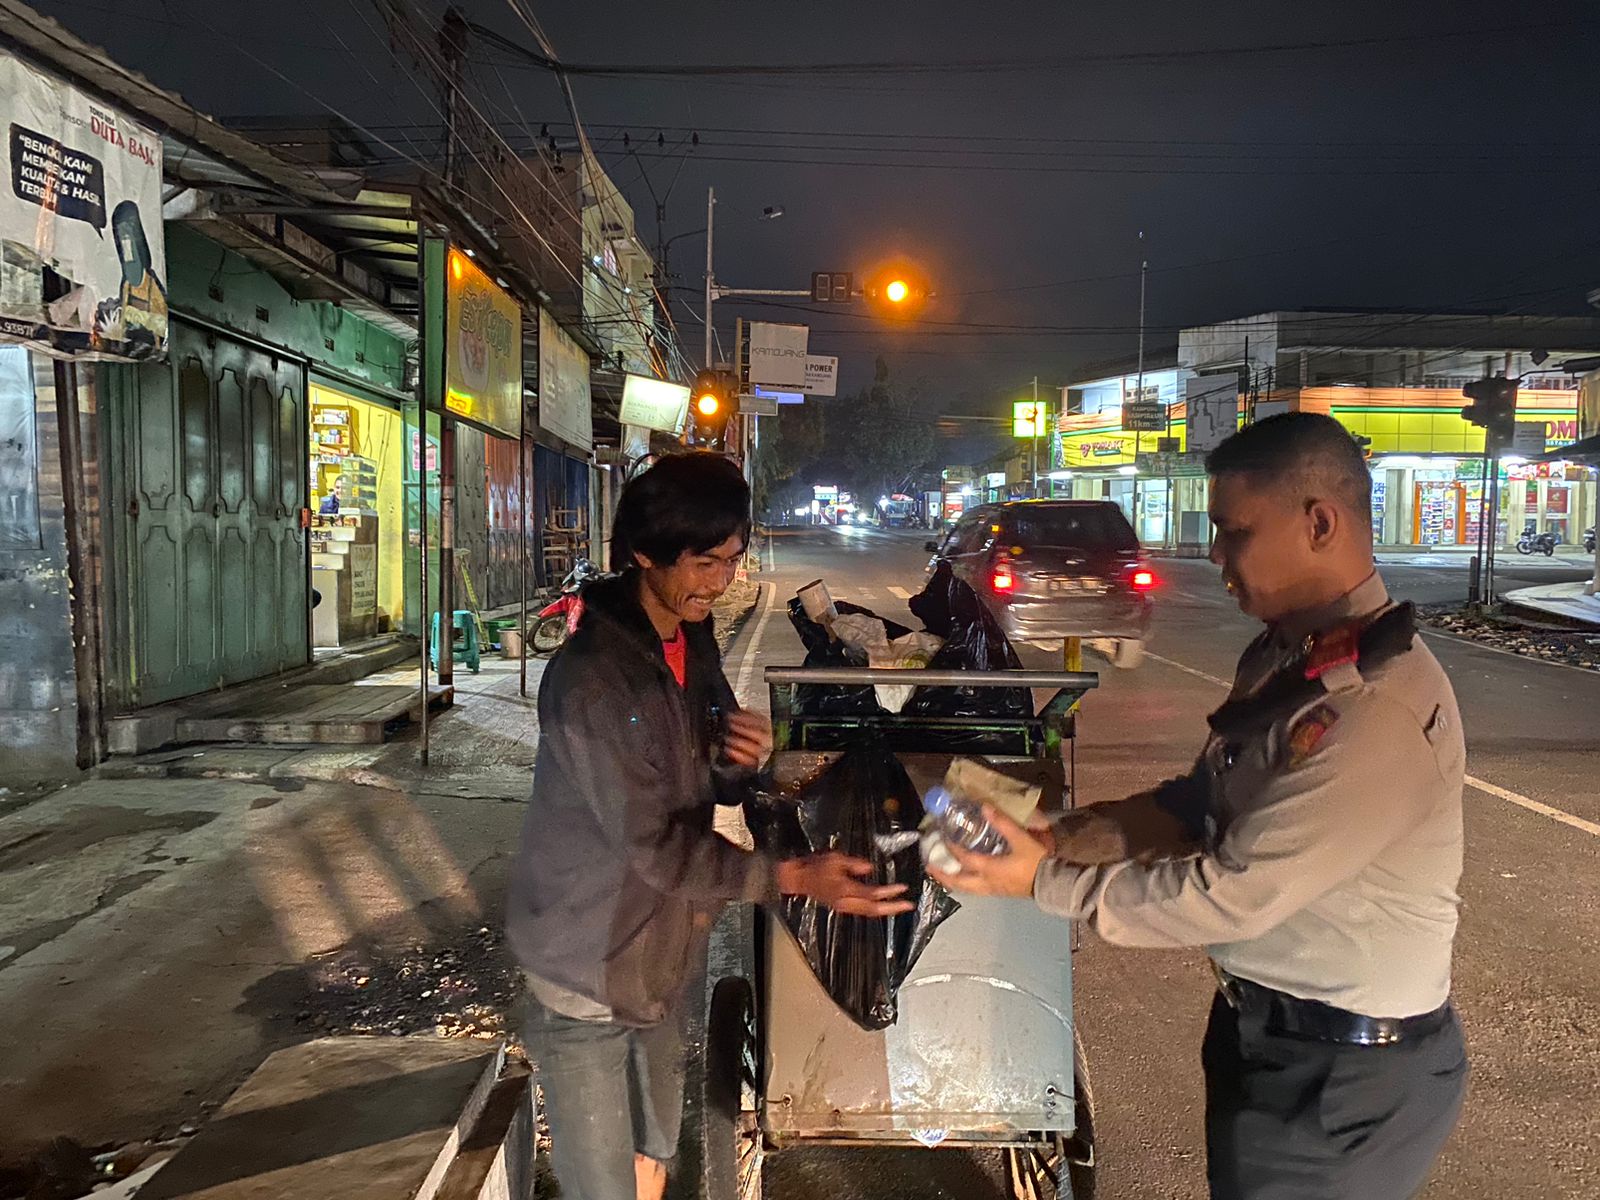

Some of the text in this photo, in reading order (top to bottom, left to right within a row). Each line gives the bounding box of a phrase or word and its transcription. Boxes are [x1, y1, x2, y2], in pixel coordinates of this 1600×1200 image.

[91, 116, 125, 149] DUTA
[752, 347, 805, 358] KAMOJANG
[810, 364, 833, 373] POWER
